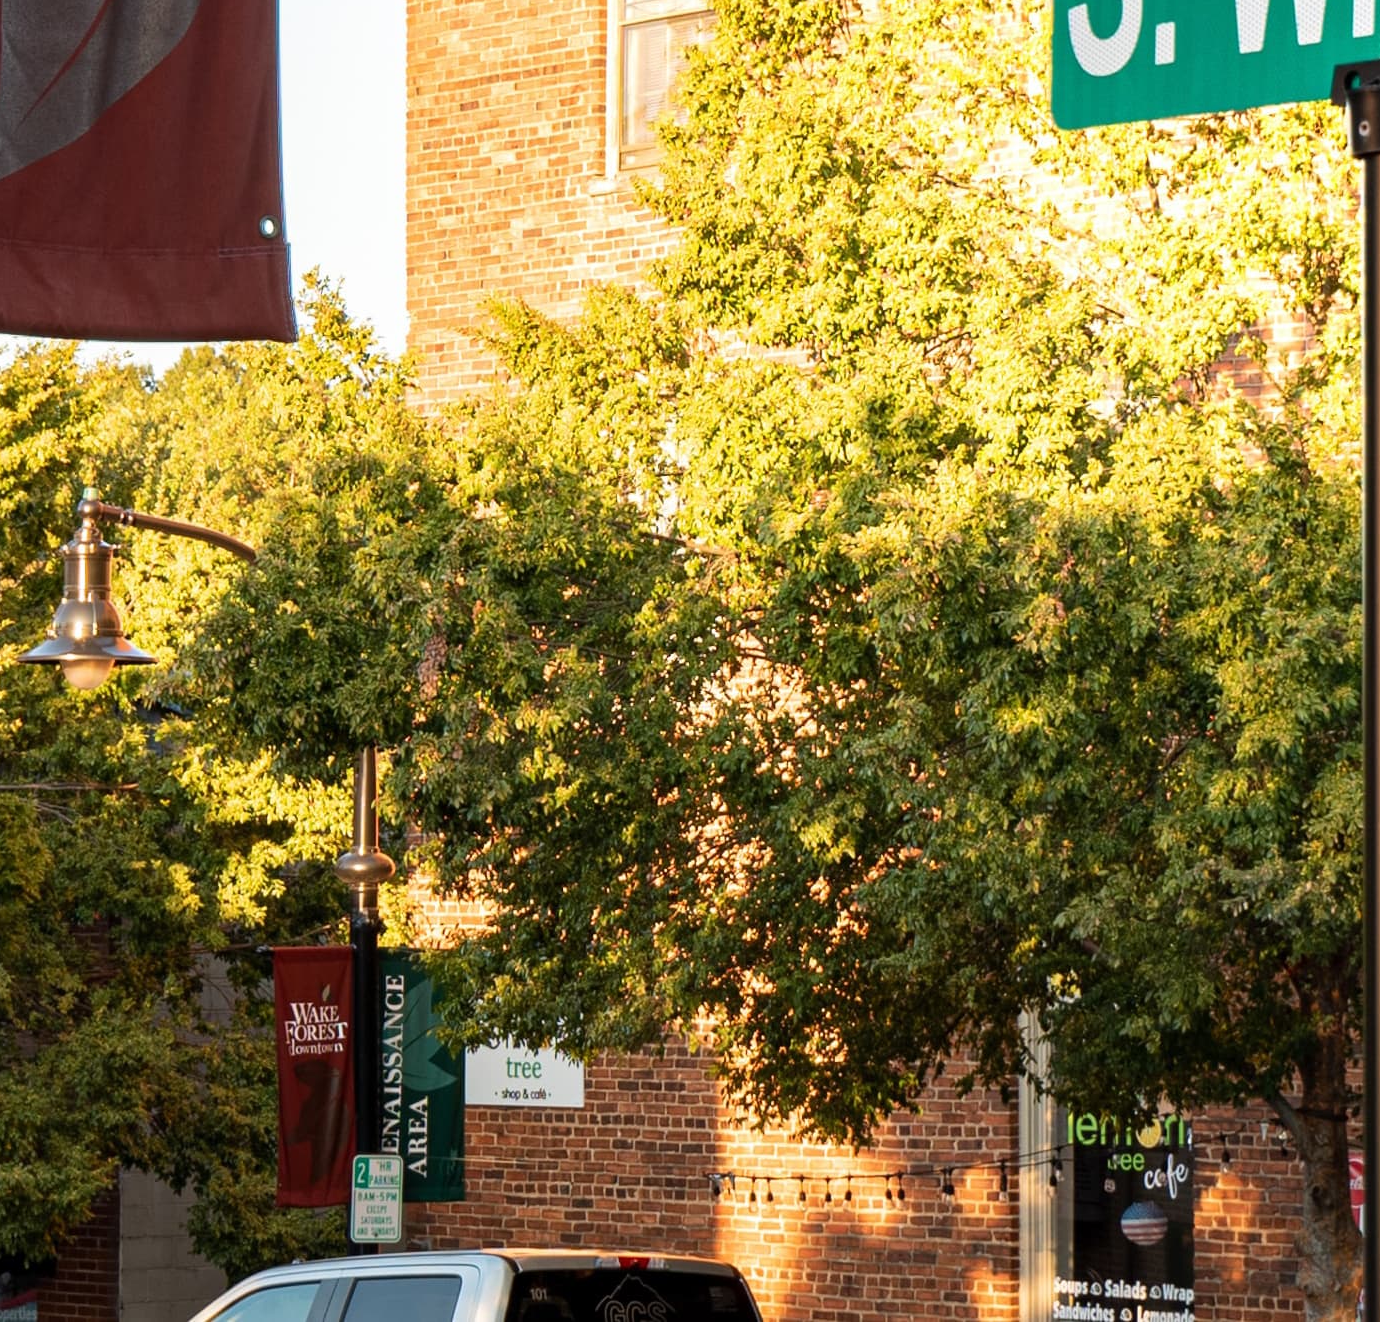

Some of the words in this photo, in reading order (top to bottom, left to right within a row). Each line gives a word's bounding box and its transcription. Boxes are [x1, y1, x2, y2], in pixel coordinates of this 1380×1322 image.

[290, 1002, 340, 1025] WAKE
[284, 1021, 348, 1044] FOREST
[289, 1040, 344, 1056] downtown
[381, 975, 405, 1155] ENAISSANCE
[506, 1057, 543, 1079] tree
[502, 1088, 521, 1101] shop
[522, 1088, 529, 1099] &
[408, 1095, 429, 1178] AREA
[356, 1162, 366, 1184] 2
[530, 1288, 548, 1301] 101
[1053, 1277, 1089, 1297] Soups
[1104, 1279, 1148, 1301] Salads
[1052, 1300, 1116, 1322] Sandwiches
